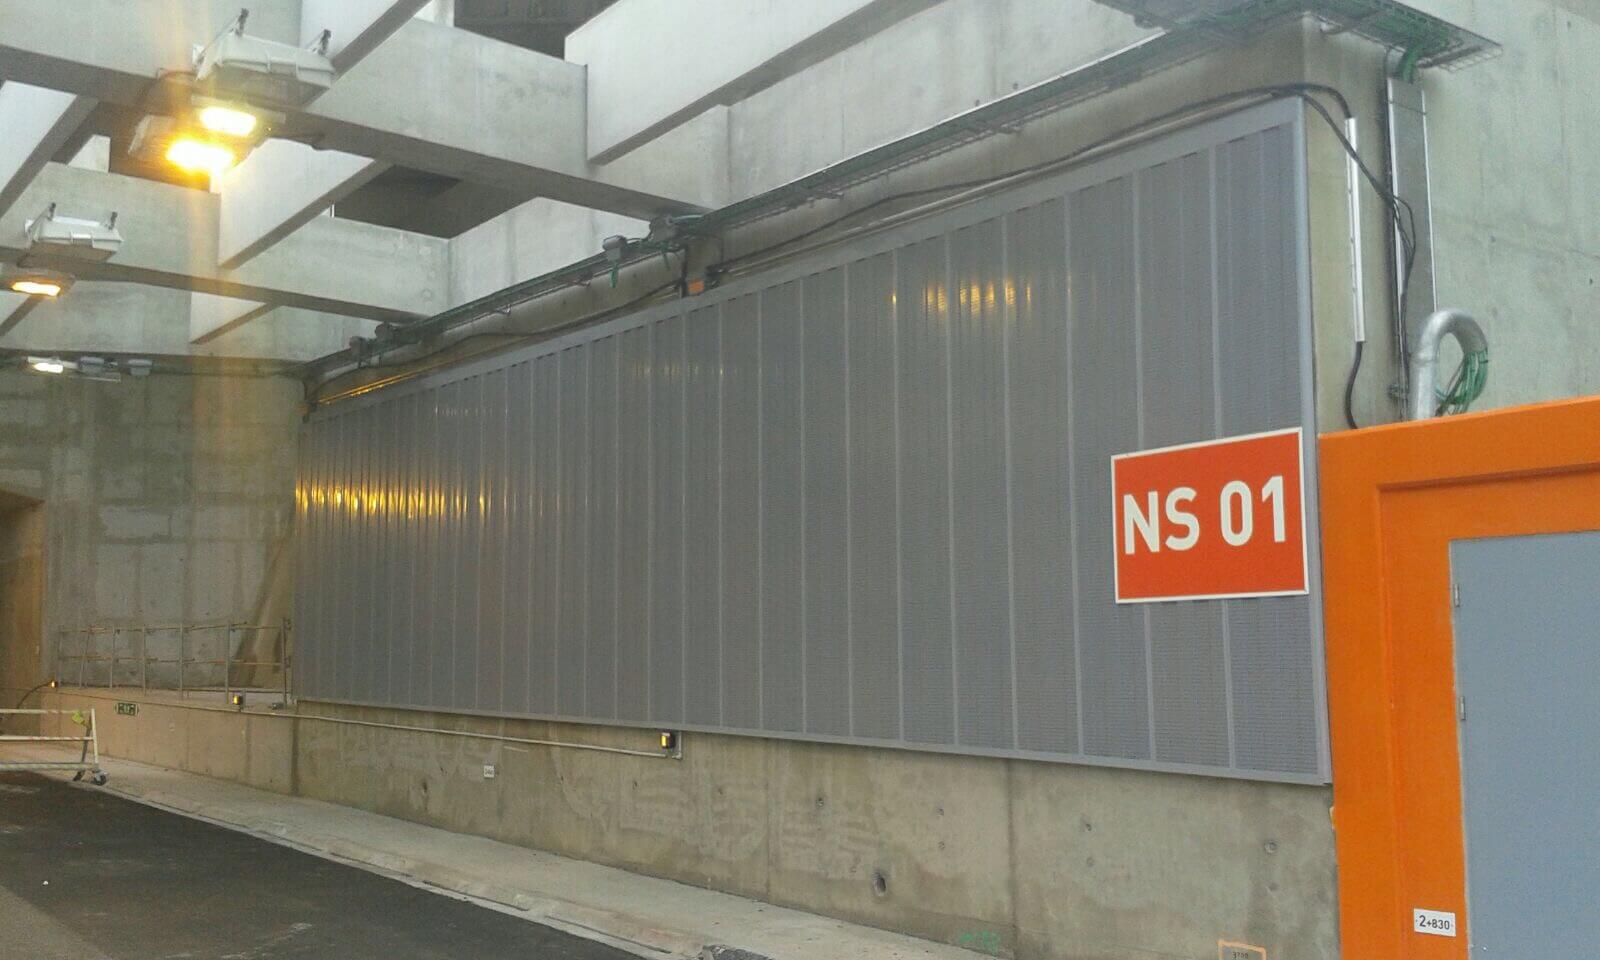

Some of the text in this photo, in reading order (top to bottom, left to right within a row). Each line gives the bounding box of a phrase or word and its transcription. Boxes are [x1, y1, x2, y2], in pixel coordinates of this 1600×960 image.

[1124, 475, 1286, 555] NS 01
[1419, 914, 1450, 930] 2+830
